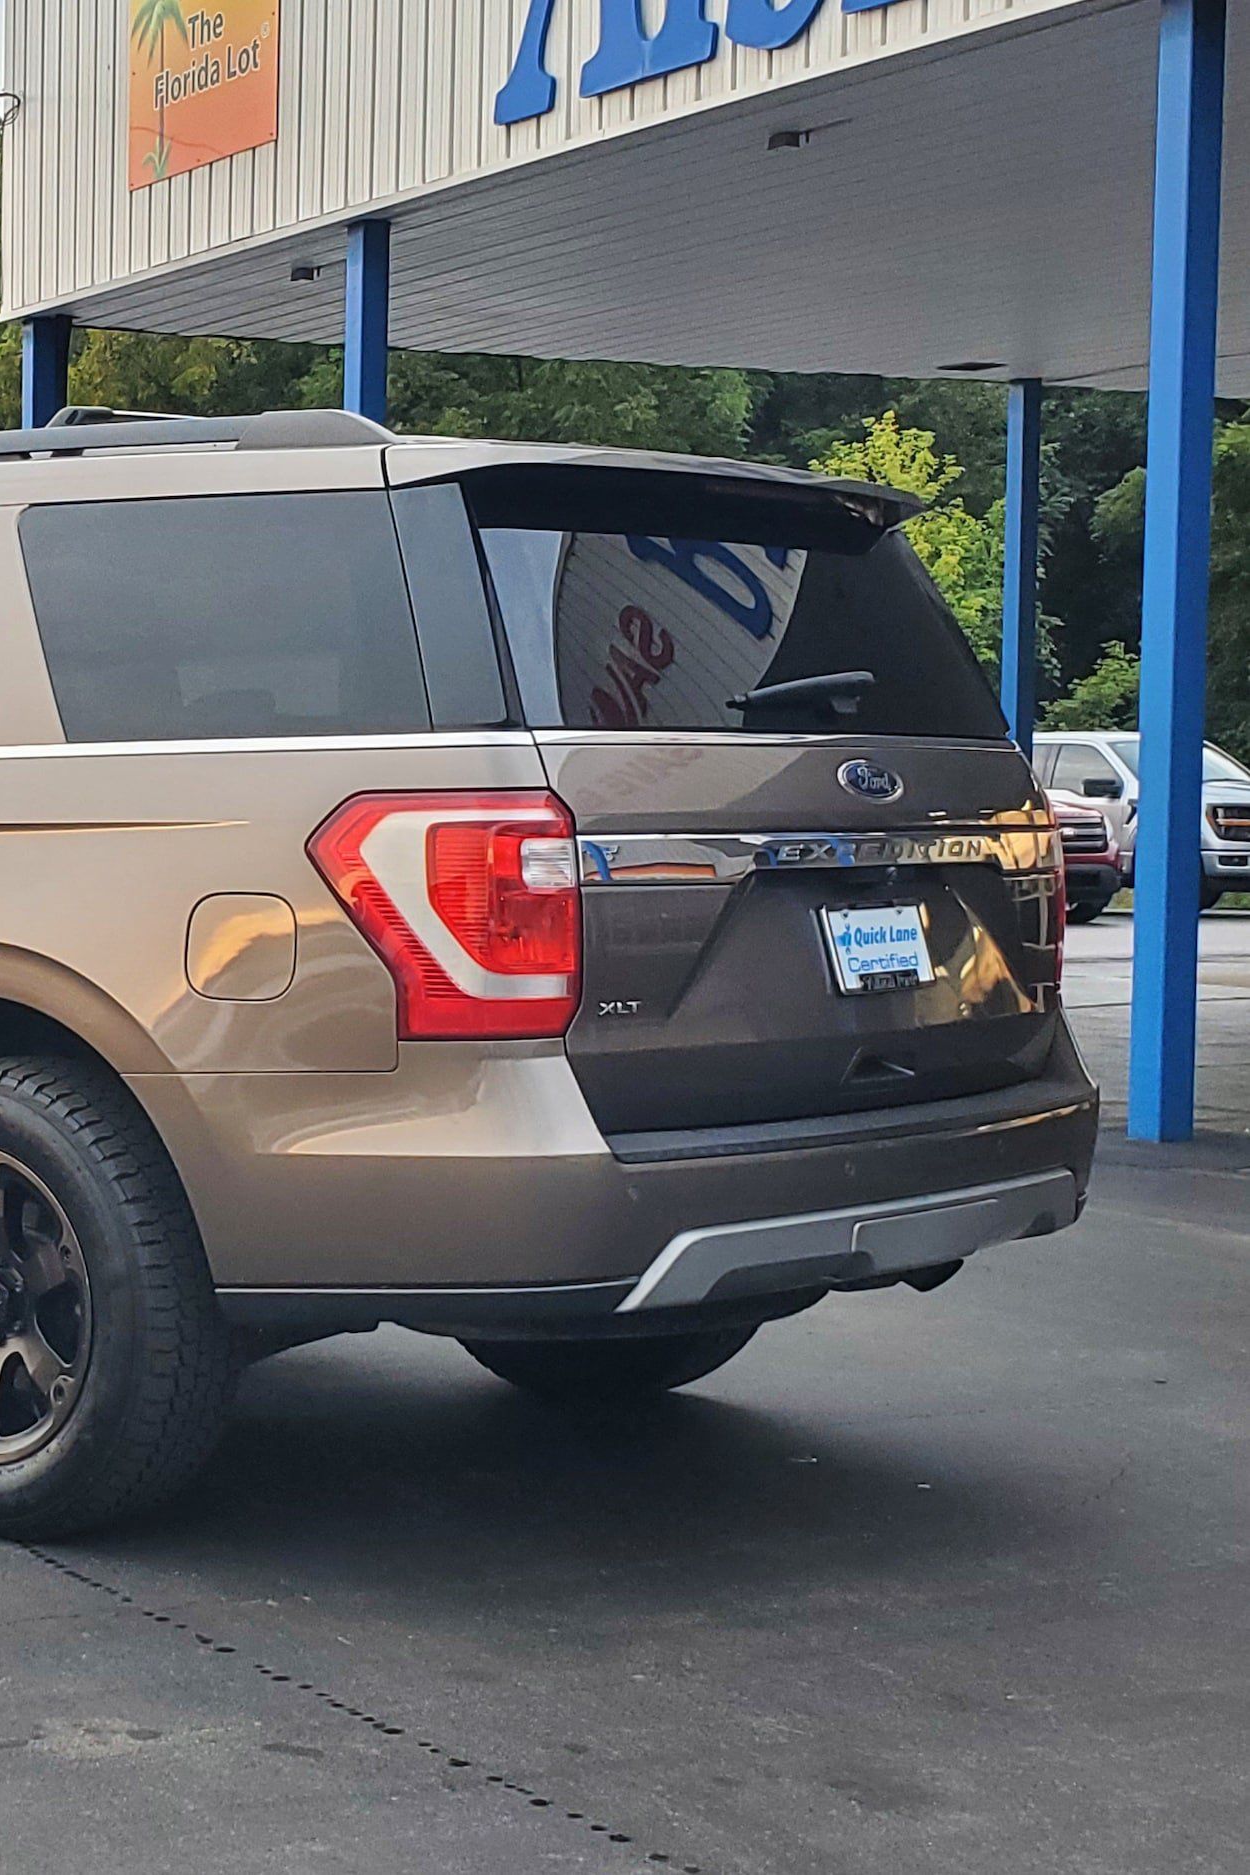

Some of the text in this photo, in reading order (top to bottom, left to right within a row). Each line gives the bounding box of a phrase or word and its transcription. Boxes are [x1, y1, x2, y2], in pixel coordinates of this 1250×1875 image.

[188, 10, 224, 49] The
[154, 38, 260, 109] Florida Lot
[857, 766, 891, 791] Ford
[854, 925, 918, 948] Quick Lane
[848, 952, 919, 973] Certified
[598, 1001, 642, 1016] XLT
